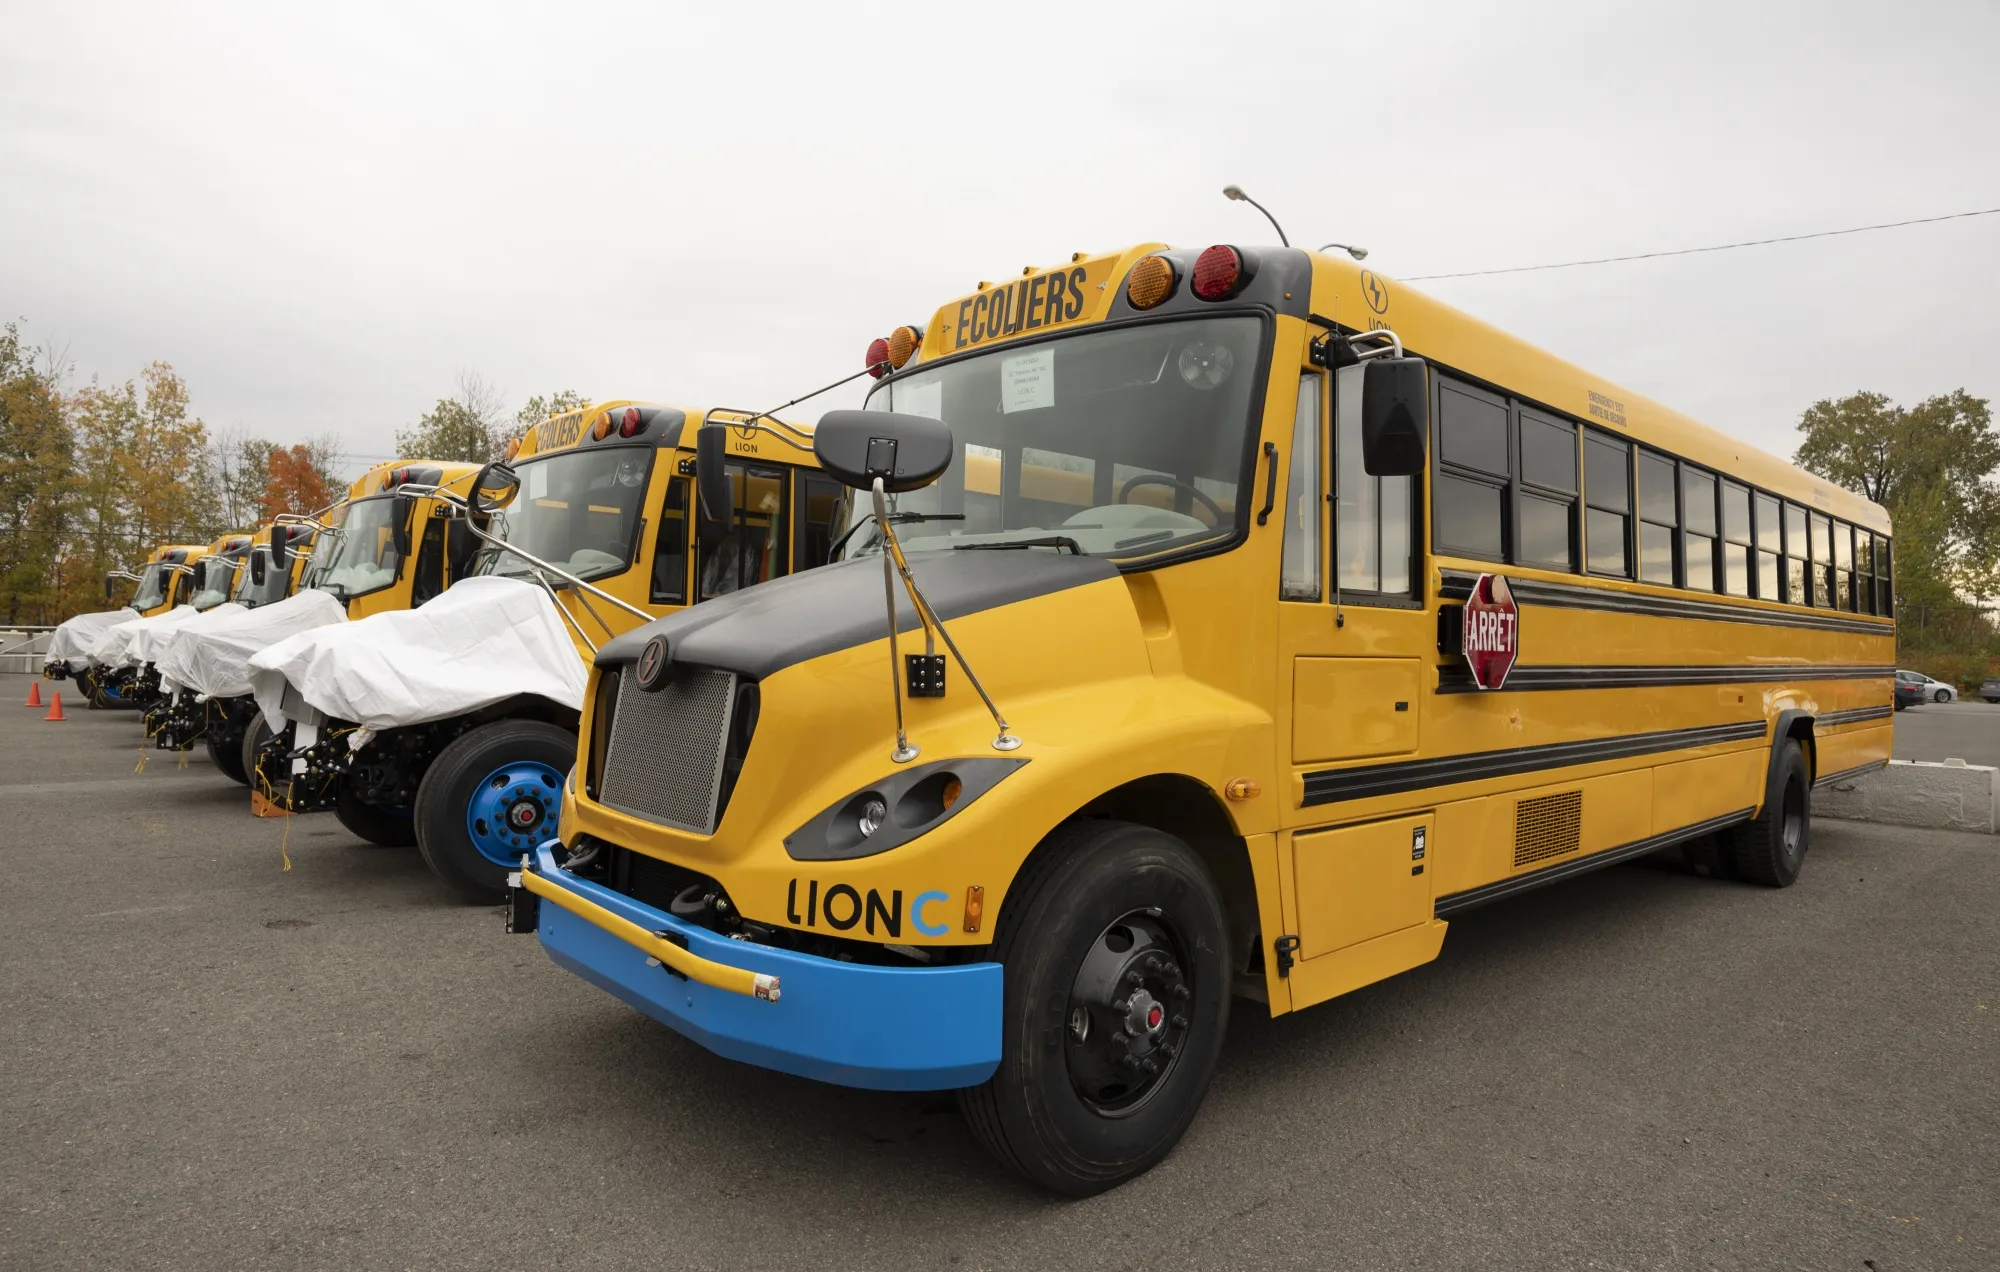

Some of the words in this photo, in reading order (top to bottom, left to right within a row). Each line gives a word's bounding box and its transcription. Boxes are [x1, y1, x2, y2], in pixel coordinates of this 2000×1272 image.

[956, 267, 1087, 349] ECOLIERS
[537, 413, 583, 452] ECOLIERS
[735, 442, 758, 453] LION
[1469, 607, 1514, 653] ARRÊT
